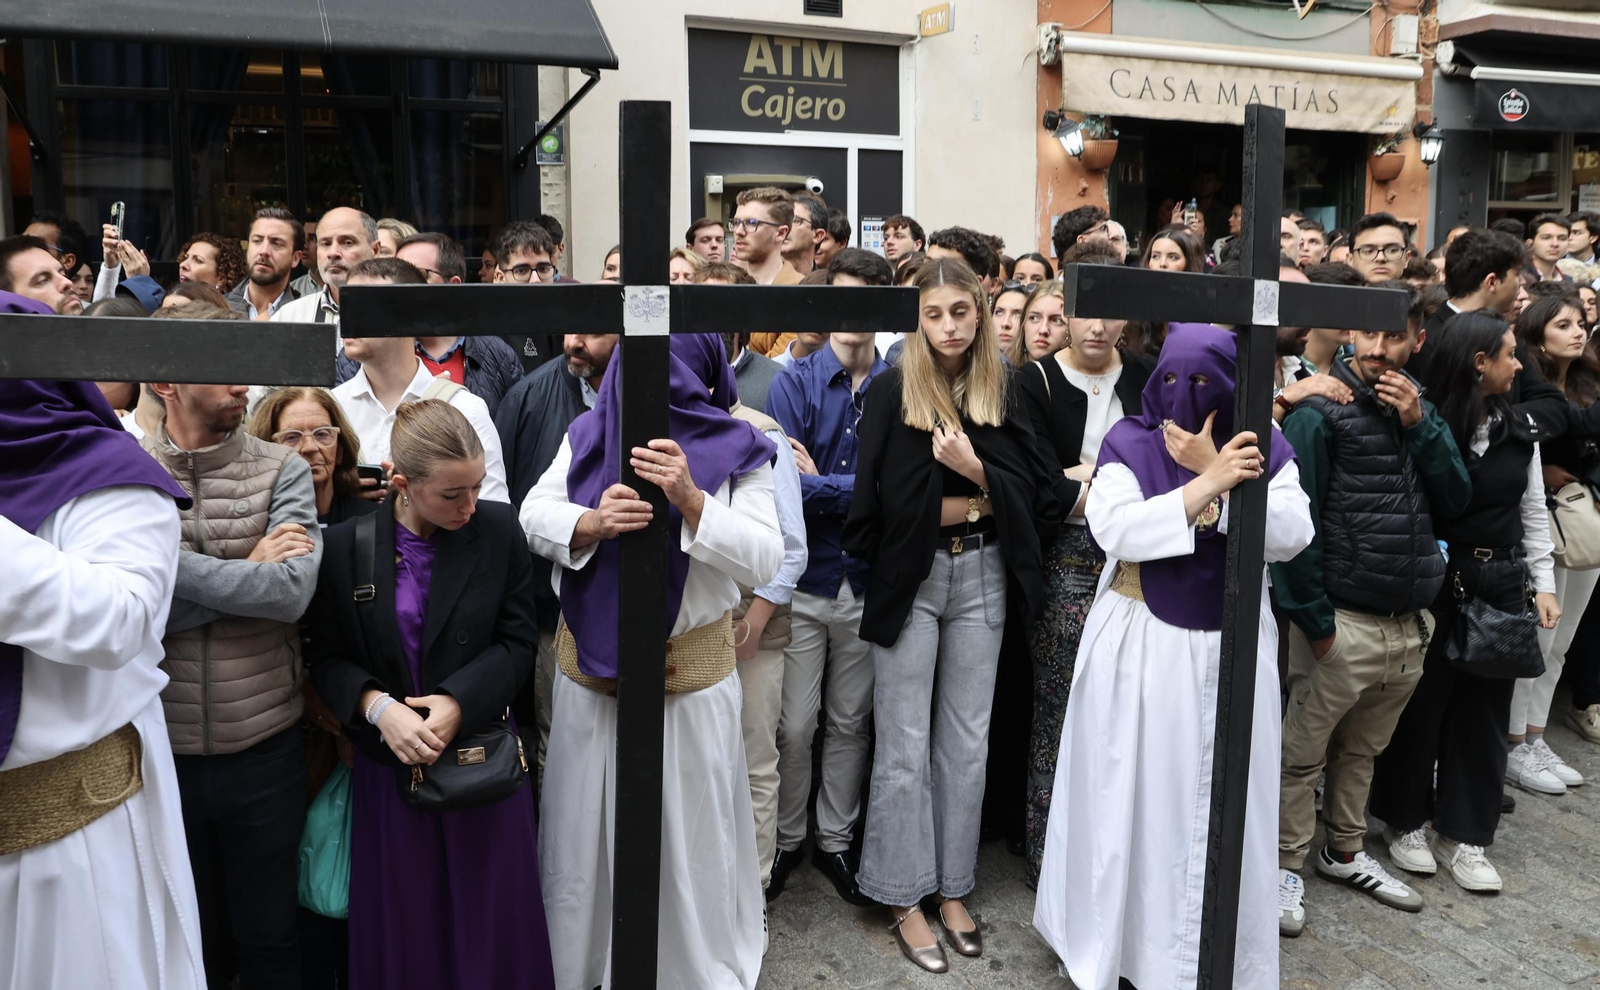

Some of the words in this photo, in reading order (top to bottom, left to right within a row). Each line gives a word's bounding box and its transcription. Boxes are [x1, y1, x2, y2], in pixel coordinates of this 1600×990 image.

[925, 10, 946, 30] ATM
[743, 35, 844, 79] ATM
[741, 85, 846, 125] Cajero
[1109, 68, 1201, 104] CASA
[1217, 80, 1340, 114] MATÍAS
